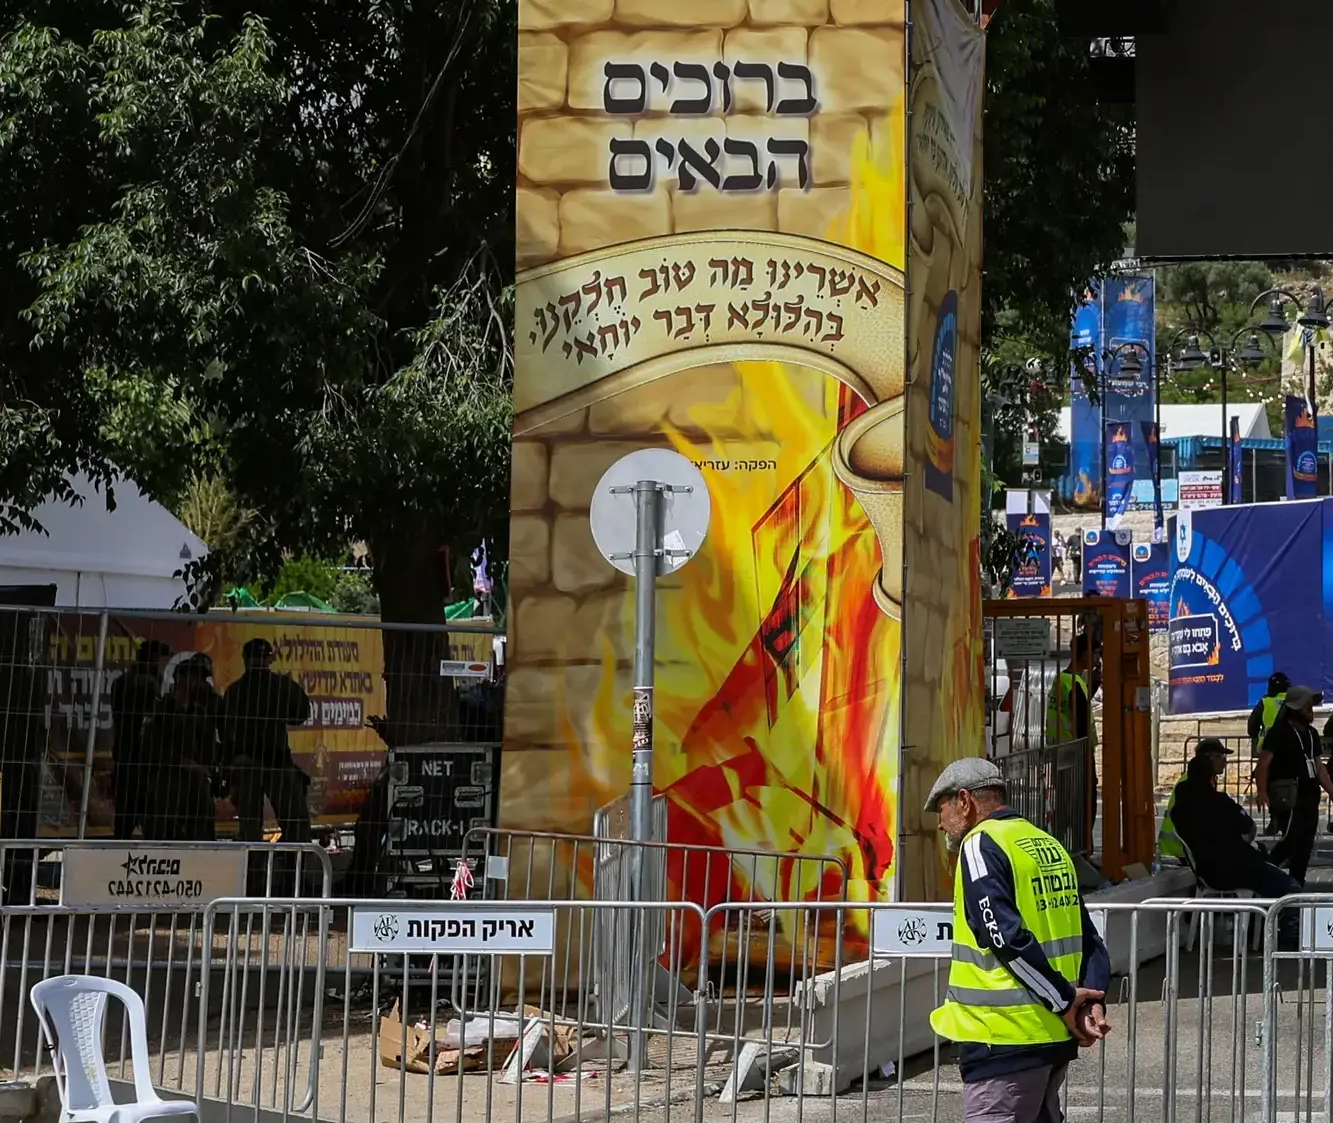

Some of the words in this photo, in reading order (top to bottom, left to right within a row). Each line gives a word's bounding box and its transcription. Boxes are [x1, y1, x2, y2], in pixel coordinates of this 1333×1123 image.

[603, 60, 818, 115] ברוכים
[609, 136, 809, 192] הבאים
[692, 458, 730, 471] עזריא
[734, 458, 777, 471] הפקה:
[422, 760, 454, 776] NET
[406, 918, 476, 941] הפקות
[482, 918, 535, 942] אריק
